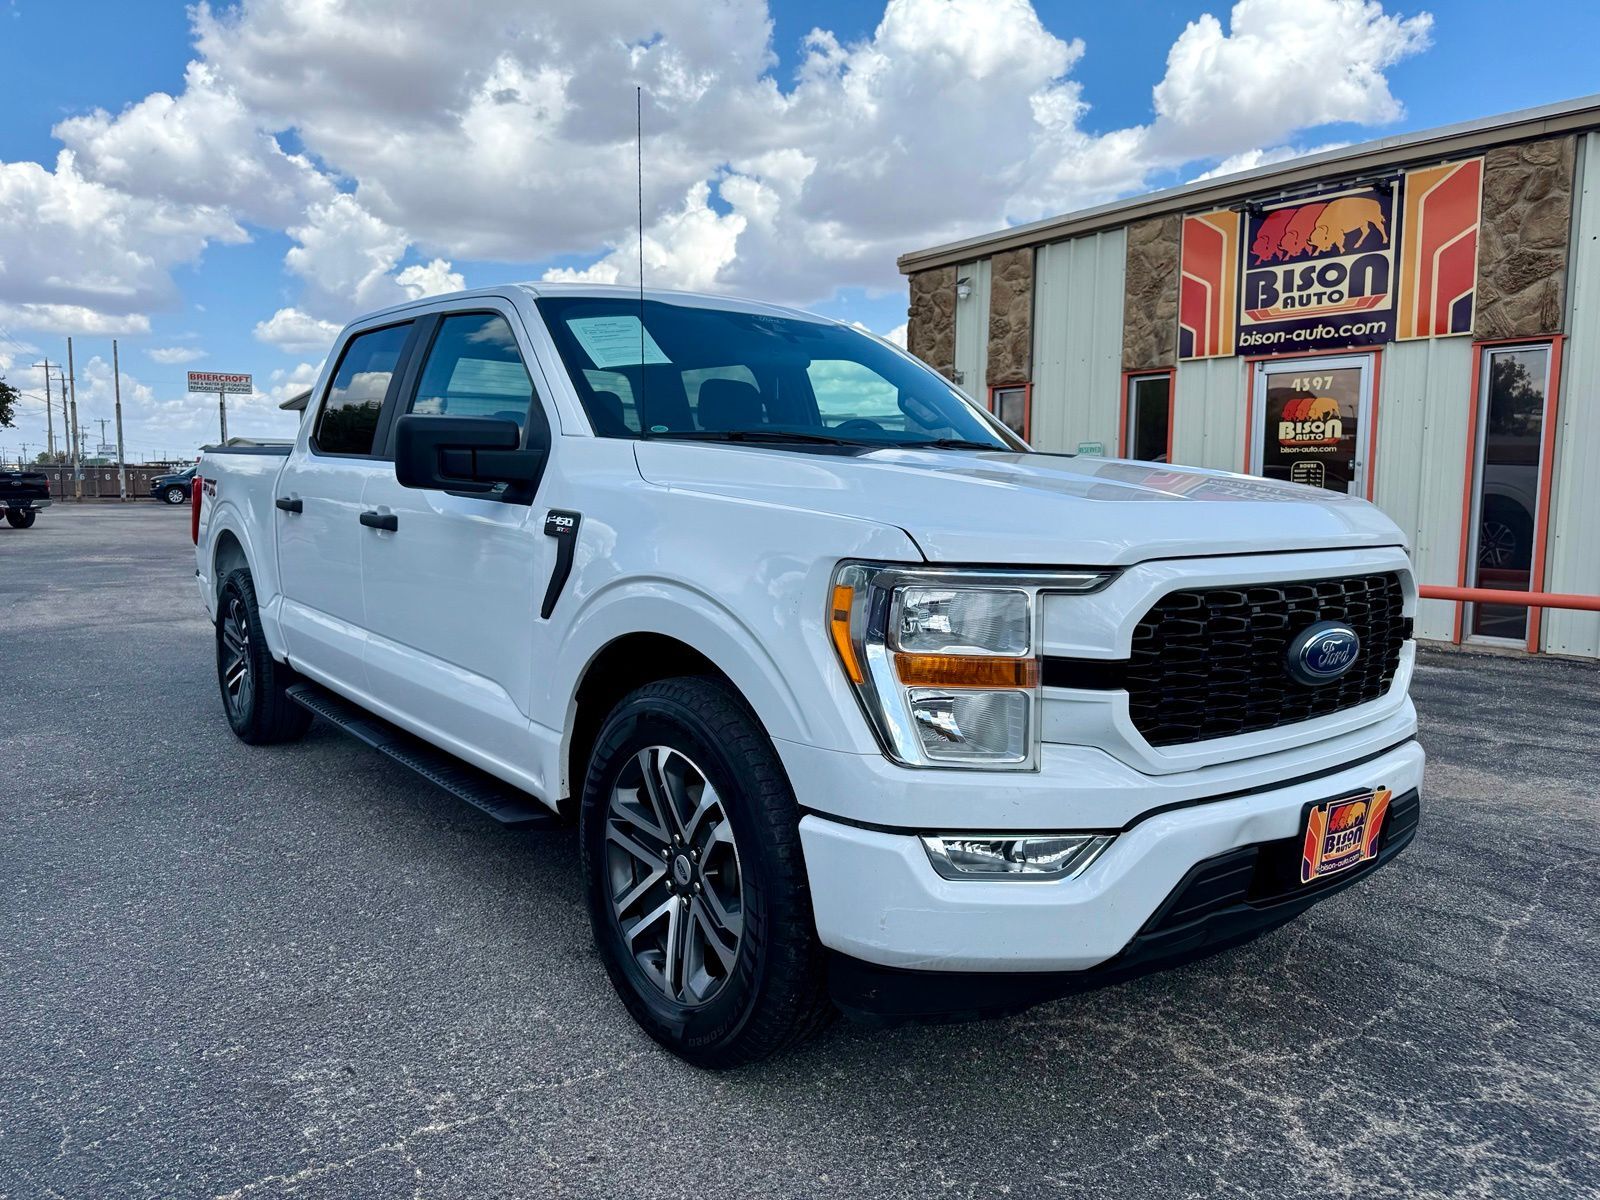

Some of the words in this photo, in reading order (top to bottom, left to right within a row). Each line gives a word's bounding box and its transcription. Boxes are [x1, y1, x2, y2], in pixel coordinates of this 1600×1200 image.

[1245, 253, 1390, 310] BISON
[1282, 290, 1344, 310] AUTO
[1239, 320, 1387, 347] bison-auto.com
[189, 374, 250, 383] BRIERCROFT
[1291, 376, 1334, 391] 4397
[1279, 419, 1342, 440] BISON
[1318, 640, 1350, 667] Ford
[1324, 825, 1363, 854] BISON
[1335, 843, 1352, 854] AUTO
[1320, 854, 1360, 872] bison-auto.com
